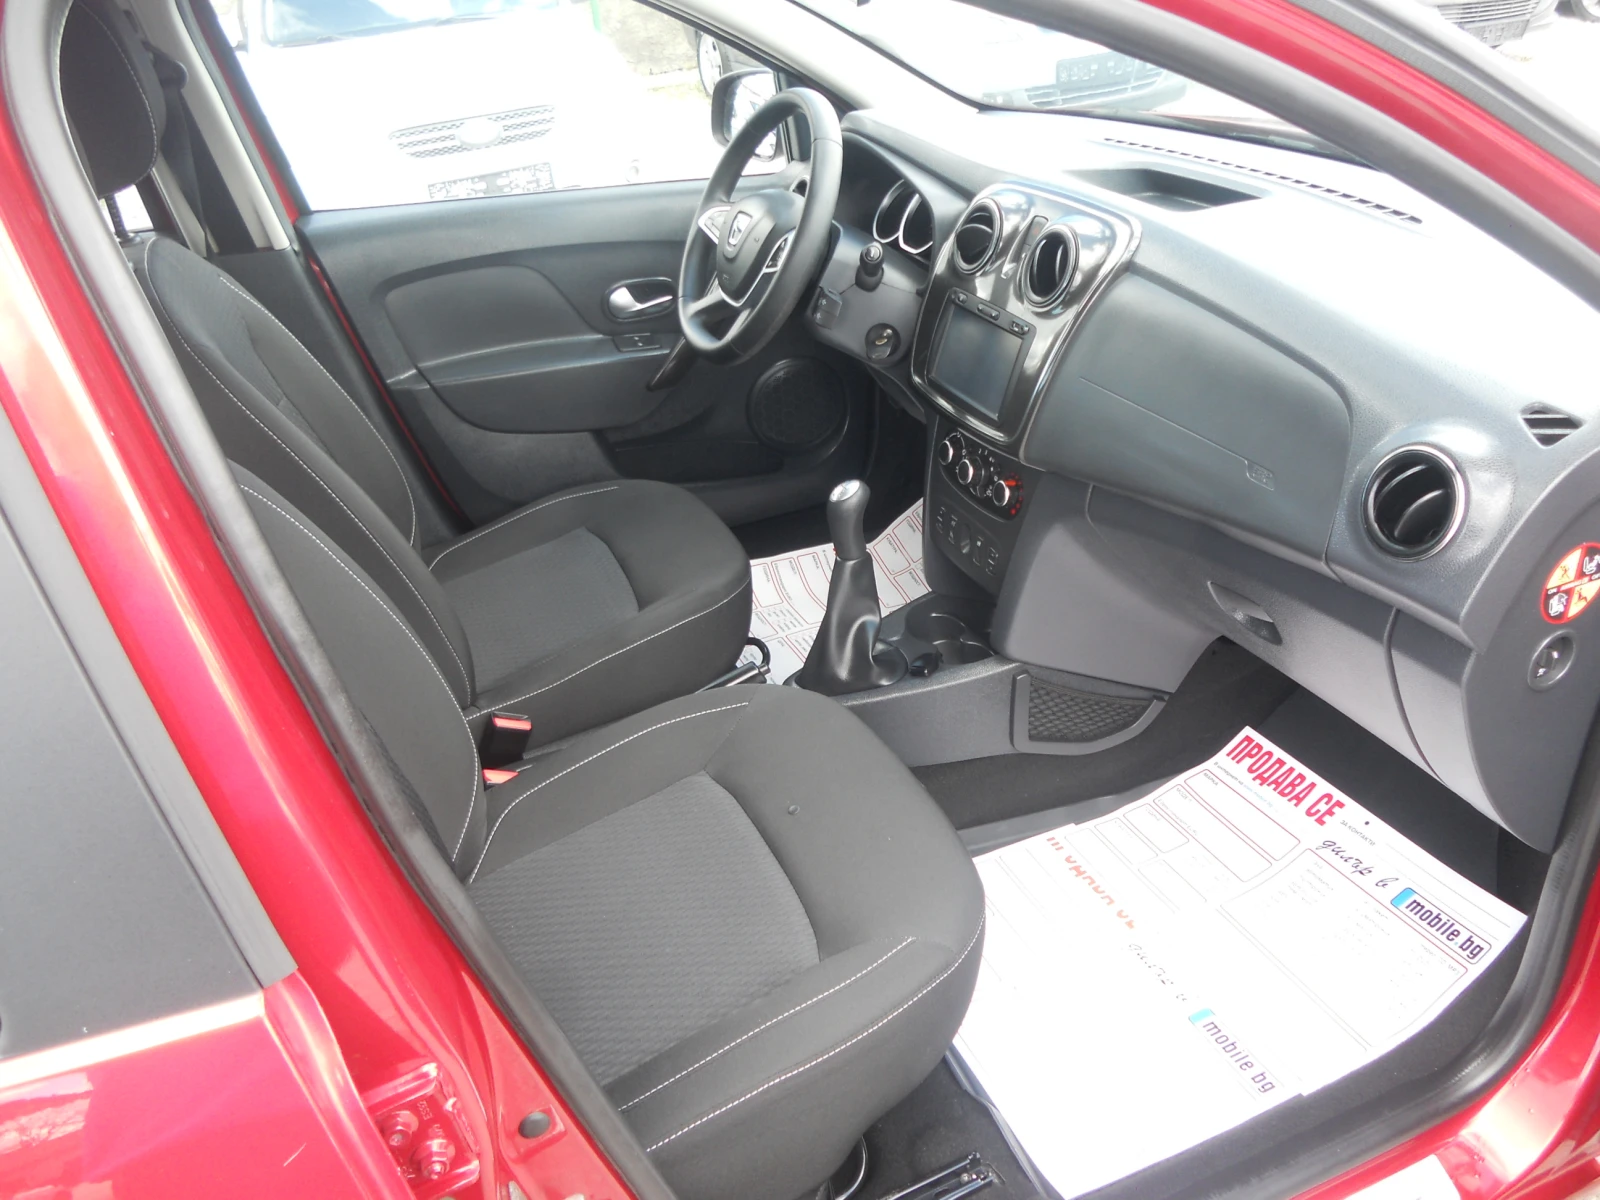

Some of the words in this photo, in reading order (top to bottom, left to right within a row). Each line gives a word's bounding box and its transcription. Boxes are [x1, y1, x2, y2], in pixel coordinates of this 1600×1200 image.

[1225, 734, 1317, 808] ПРОДАВА
[1305, 792, 1346, 827] СЕ
[1405, 899, 1485, 960] mobile.bg
